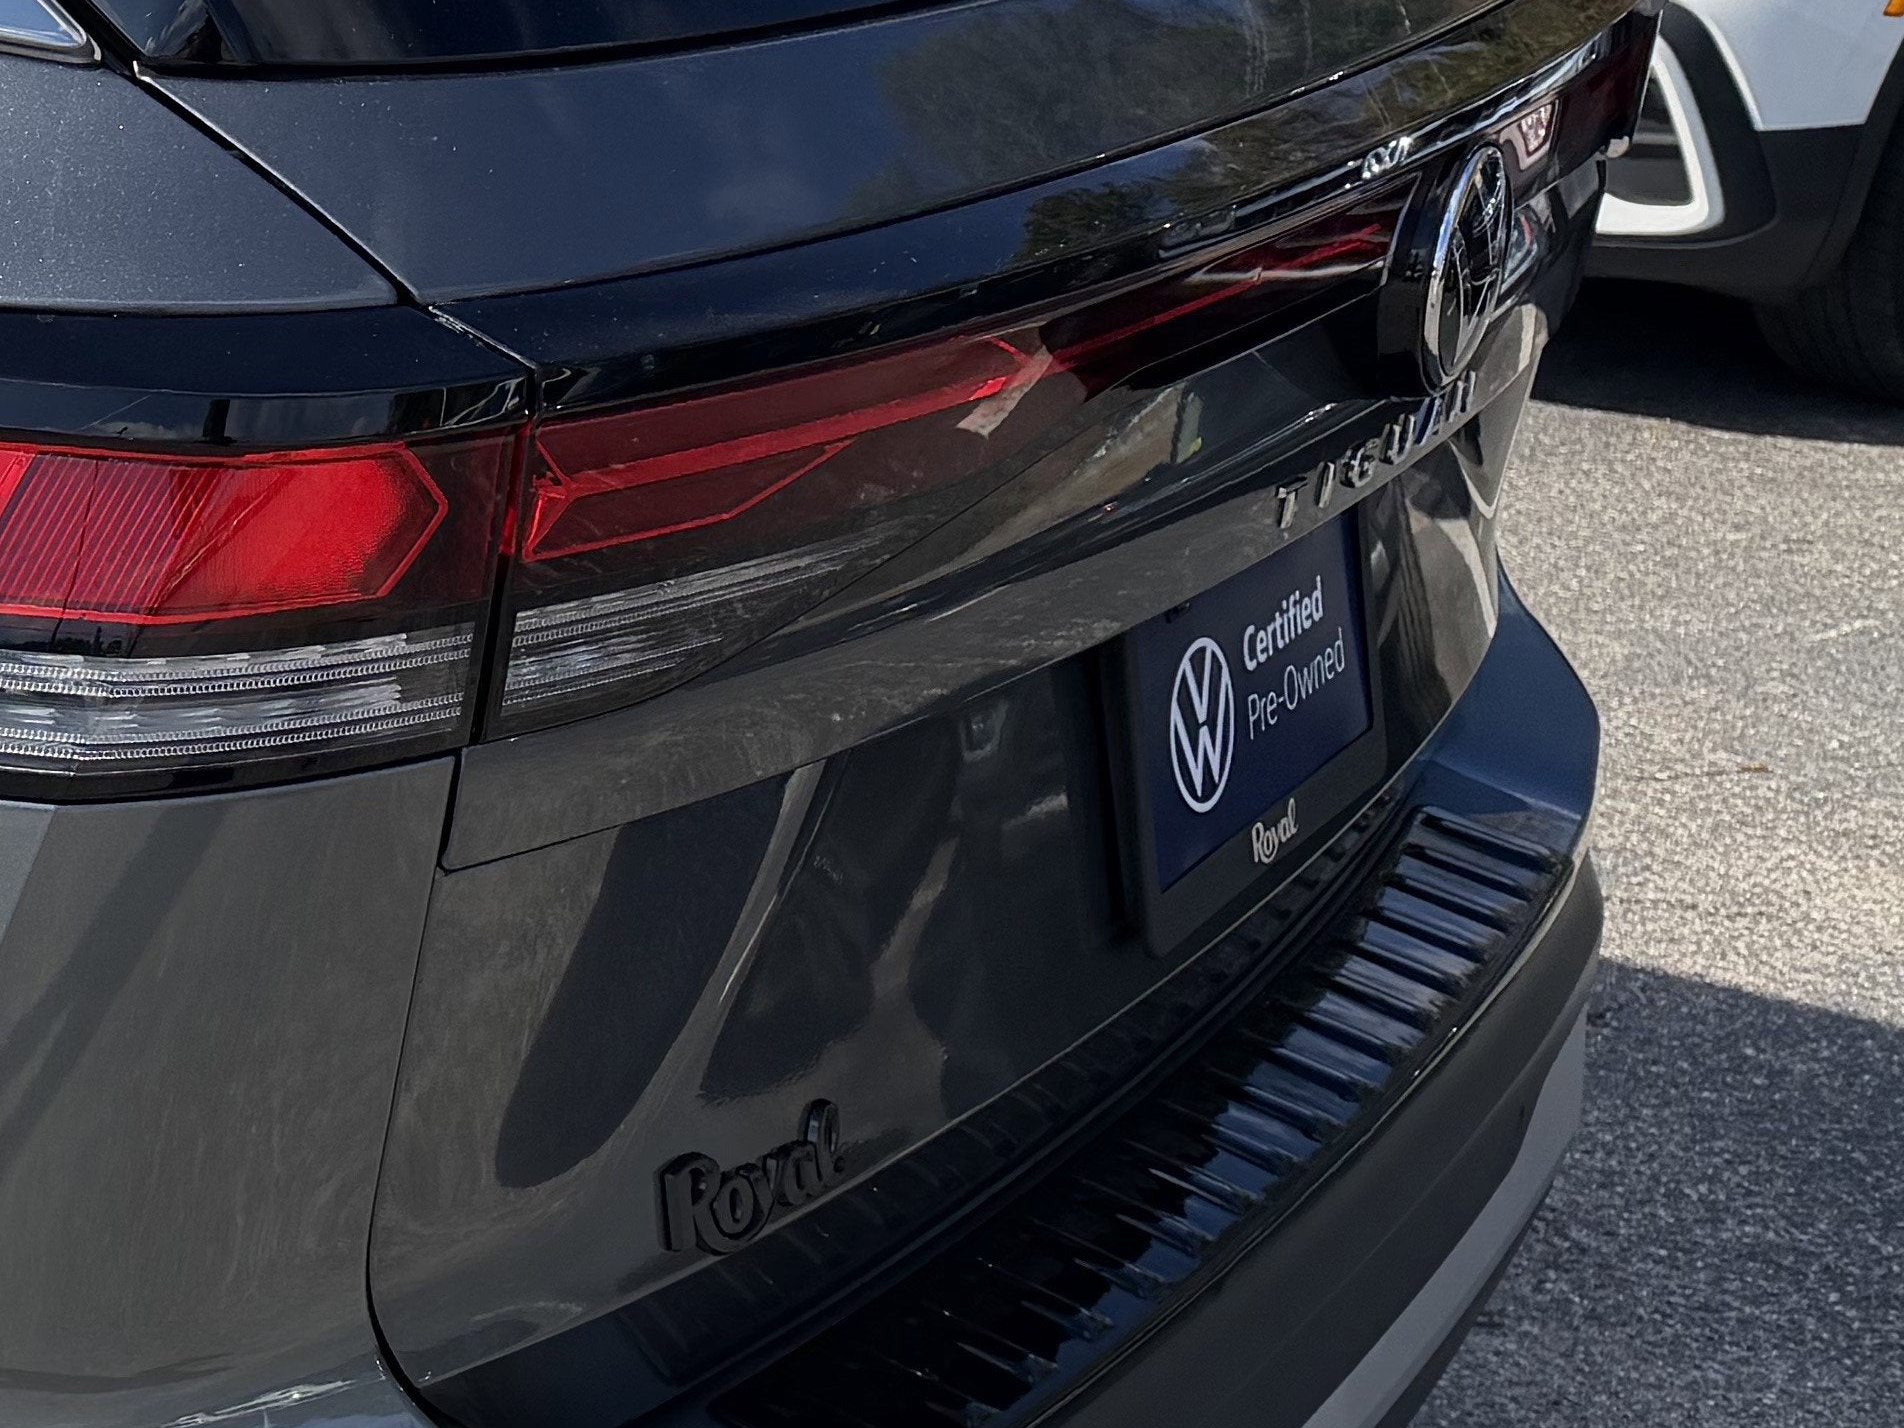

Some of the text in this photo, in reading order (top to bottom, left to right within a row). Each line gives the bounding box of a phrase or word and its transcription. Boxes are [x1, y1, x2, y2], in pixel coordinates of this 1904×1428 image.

[1243, 574, 1324, 671] Certified
[1247, 626, 1346, 740] Pre-Owned
[1251, 797, 1299, 864] Royal
[654, 1097, 845, 1256] Royal
